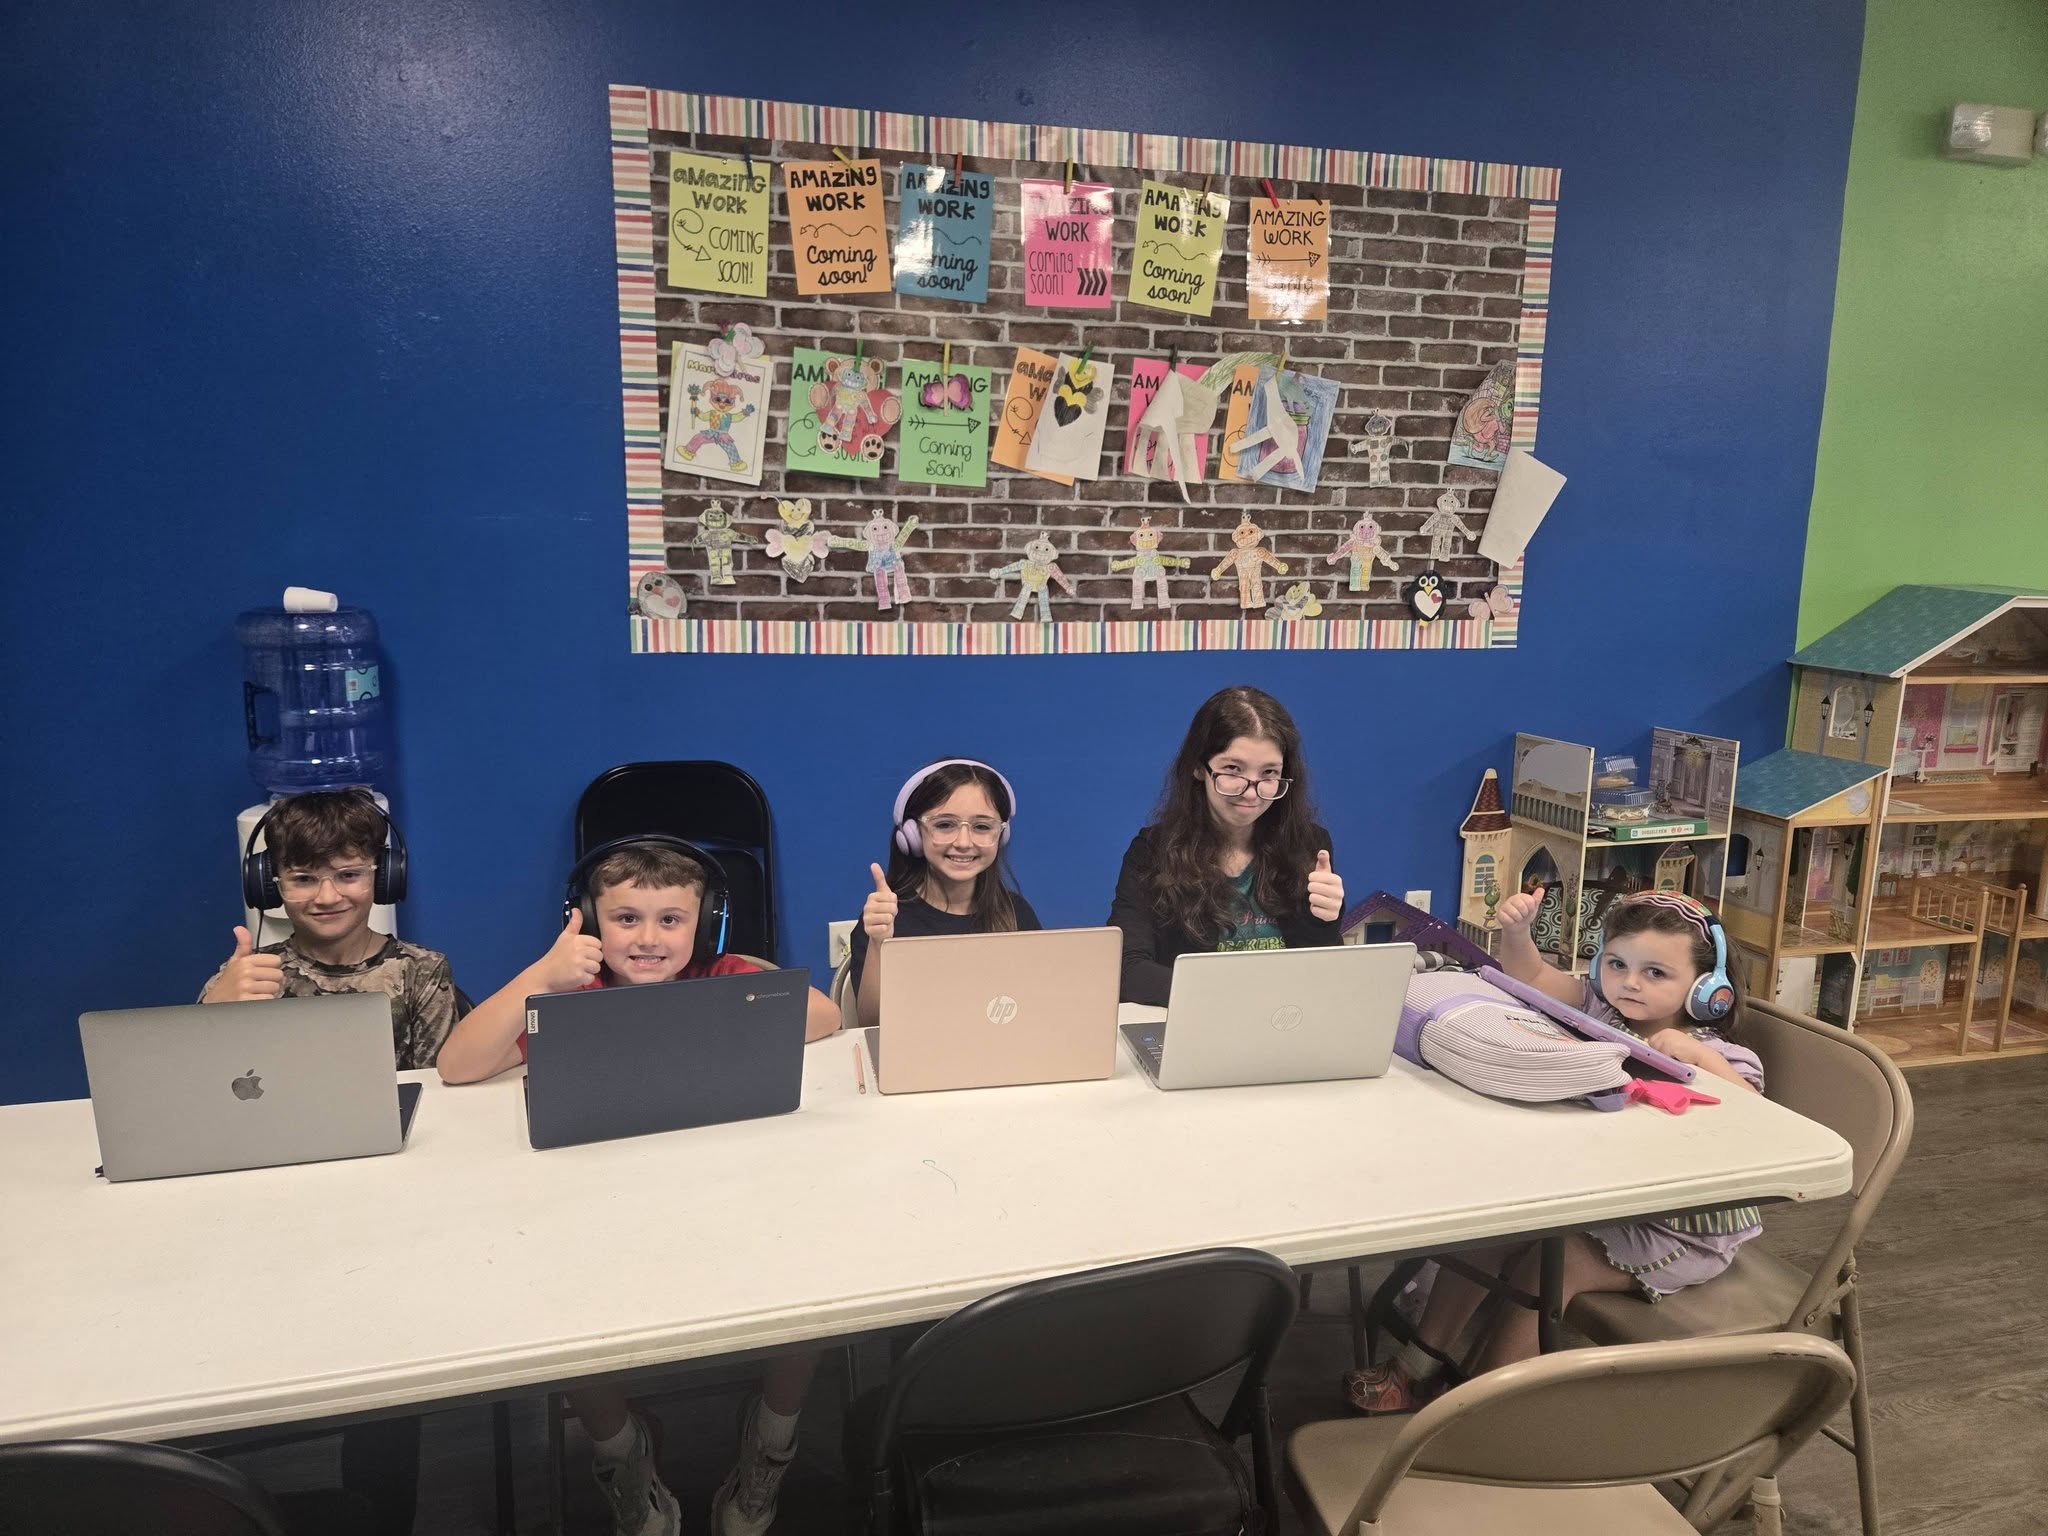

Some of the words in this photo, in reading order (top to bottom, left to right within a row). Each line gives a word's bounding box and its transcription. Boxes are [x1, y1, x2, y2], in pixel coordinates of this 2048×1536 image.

[906, 172, 990, 199] AZiNg
[692, 190, 748, 214] WORK
[805, 191, 866, 212] WORK
[918, 199, 976, 220] WORK
[1154, 214, 1207, 237] WORK
[1253, 209, 1327, 227] AMAZING
[709, 226, 765, 255] COMING
[1045, 220, 1090, 242] WORK
[1263, 229, 1314, 246] WORK
[807, 245, 878, 272] Coming
[717, 260, 754, 285] SOON!
[817, 264, 868, 286] soon!
[917, 273, 966, 291] soon!
[1143, 259, 1206, 296] Coming
[1146, 285, 1193, 304] soon!
[919, 437, 972, 462] Coming
[926, 460, 964, 478] Soon!
[988, 995, 1016, 1024] hp
